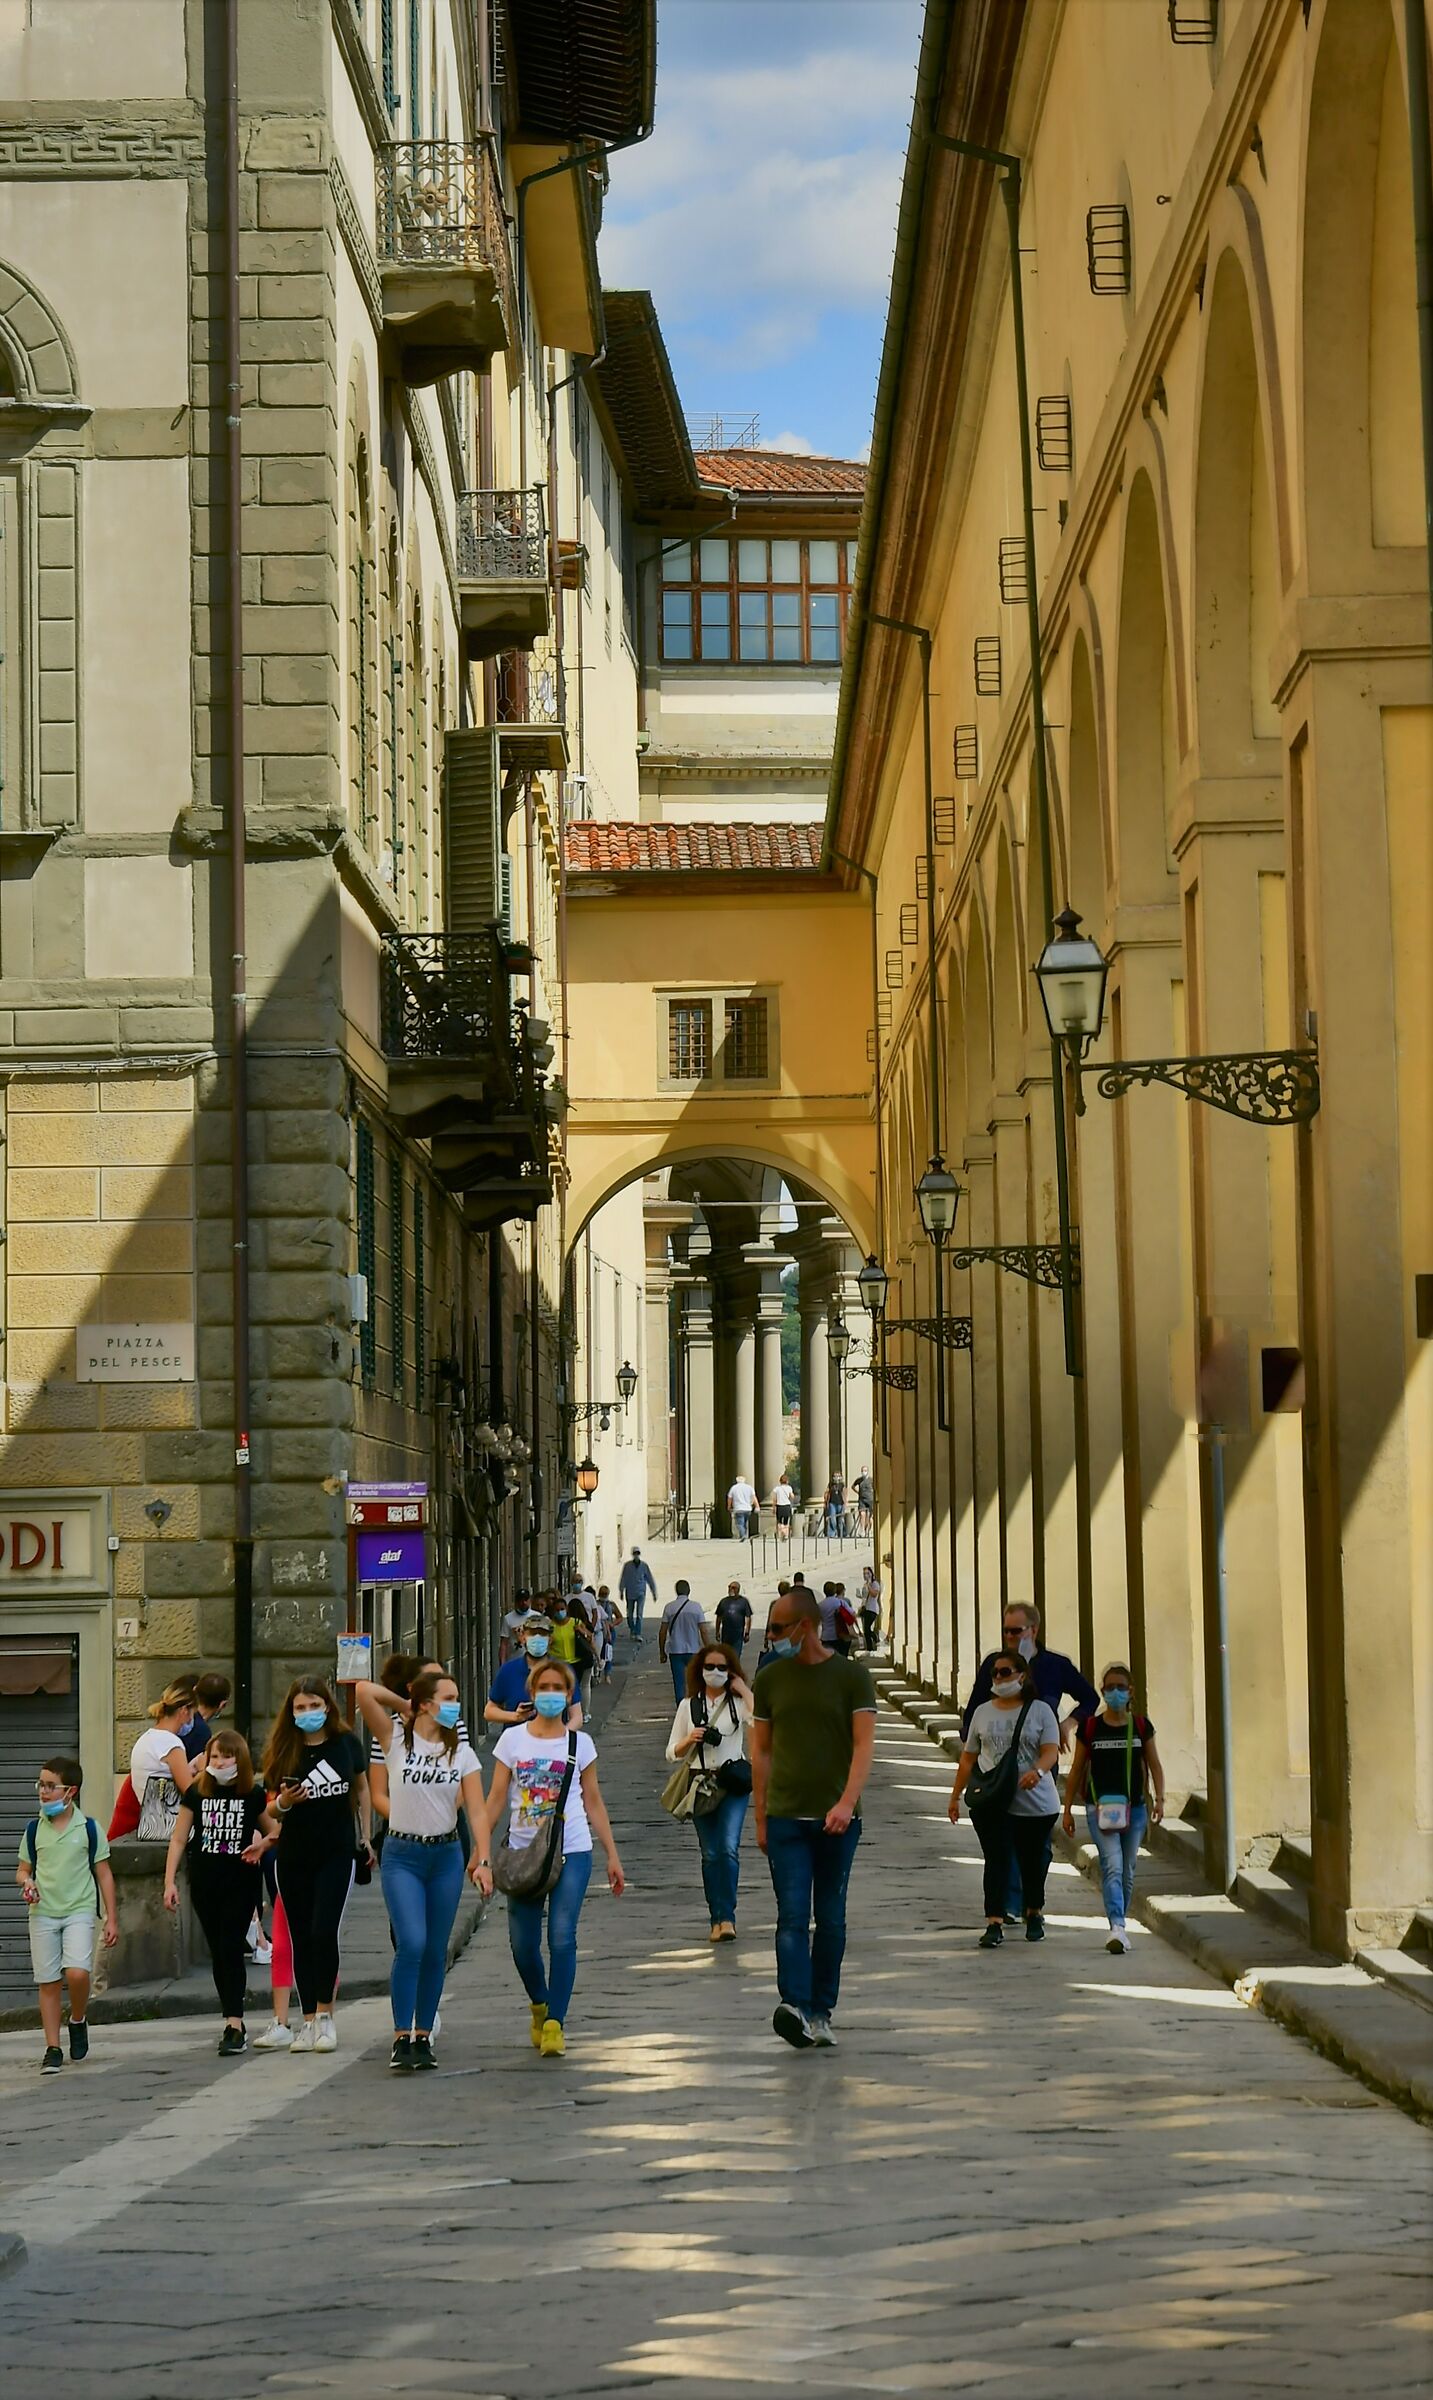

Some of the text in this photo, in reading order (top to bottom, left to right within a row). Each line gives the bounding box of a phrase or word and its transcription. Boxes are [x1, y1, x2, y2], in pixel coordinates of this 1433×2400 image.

[107, 1338, 164, 1348] PIAZZA
[89, 1357, 181, 1368] DEL PESCE
[0, 1521, 64, 1569] DI
[123, 1621, 131, 1635] 7
[402, 1768, 460, 1784] POWER
[307, 1781, 350, 1799] didas
[202, 1798, 245, 1812] GIVE ME
[202, 1811, 245, 1829] MORE
